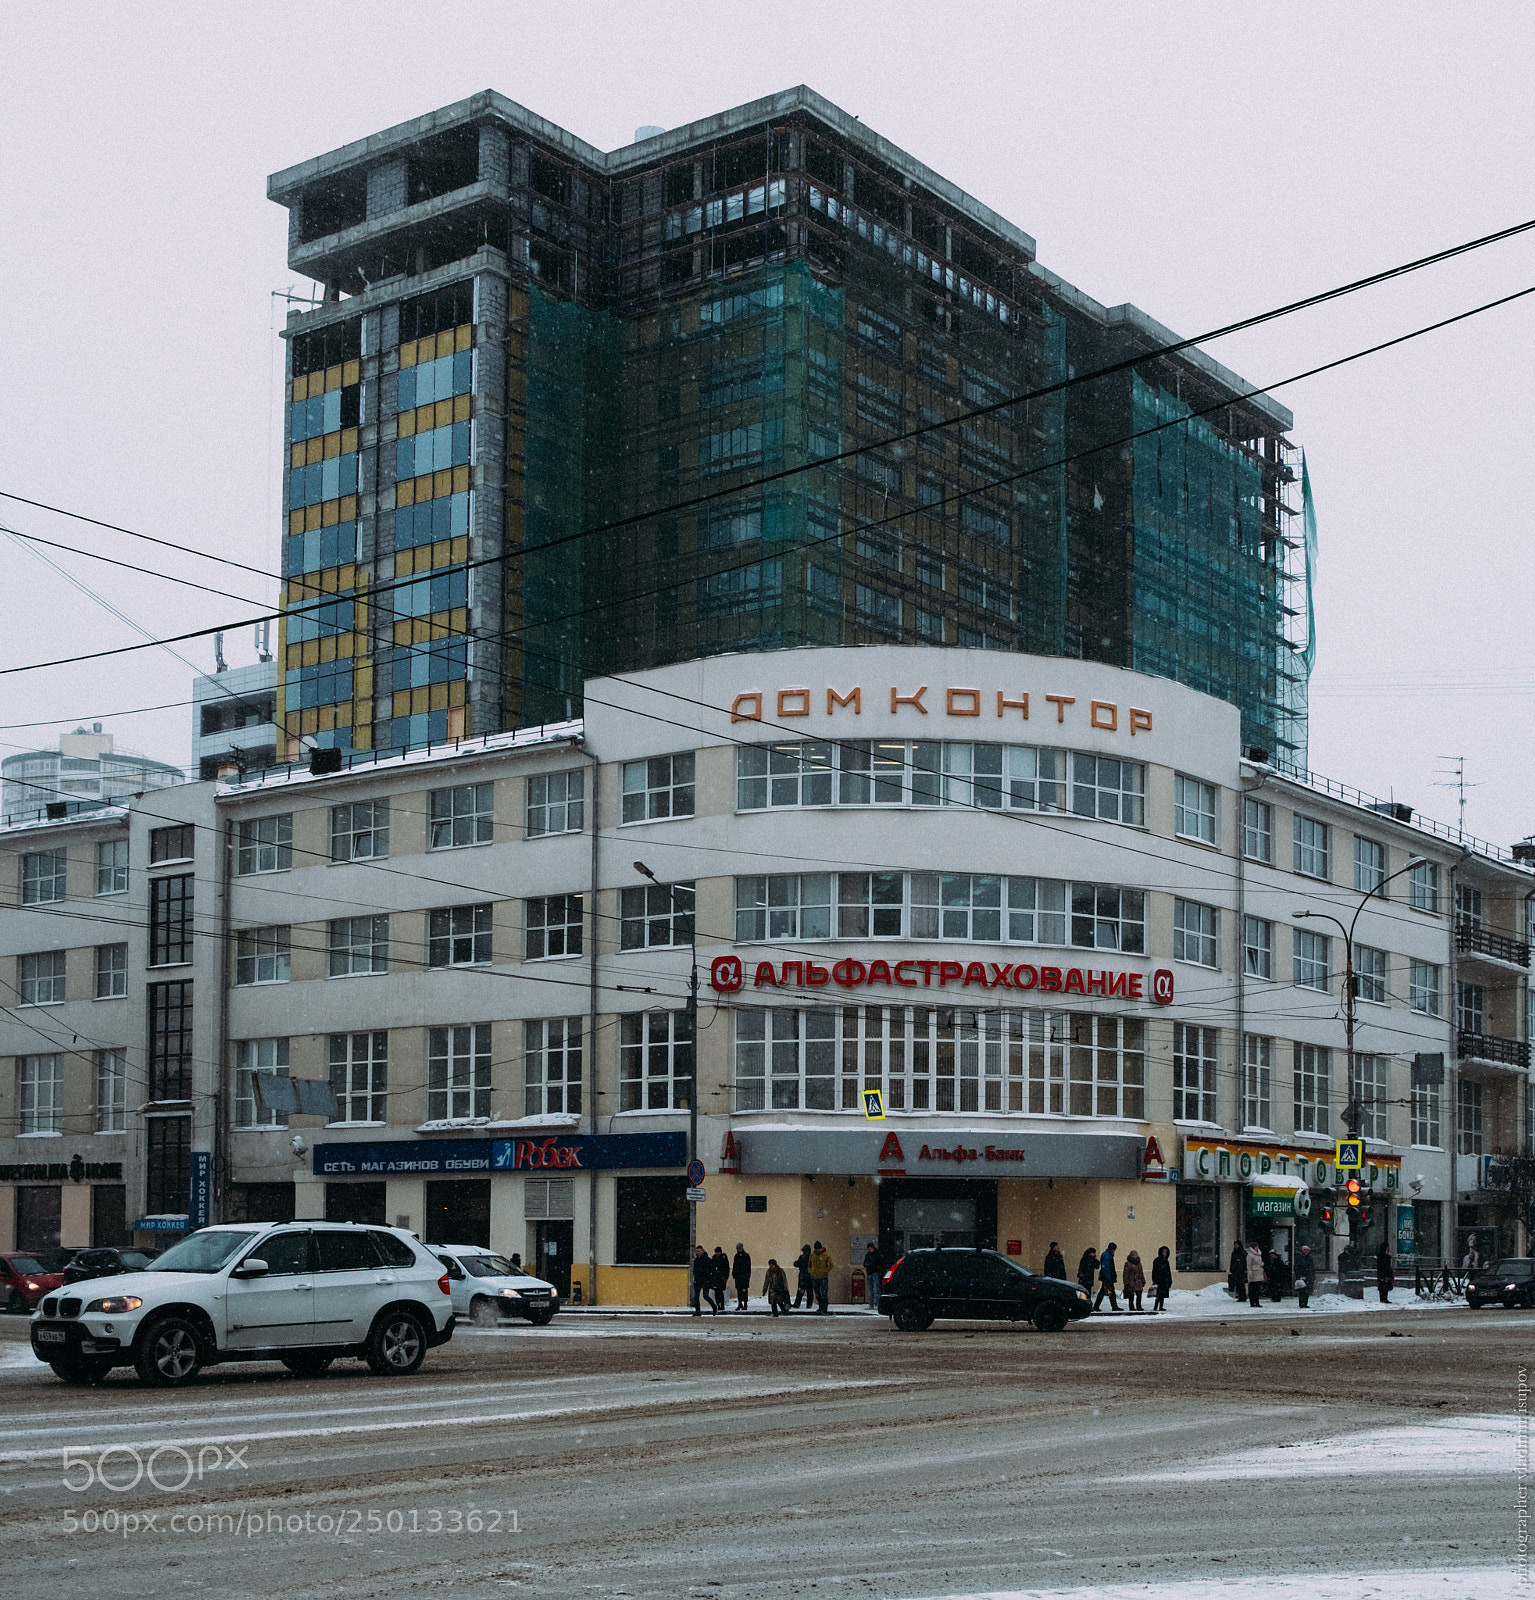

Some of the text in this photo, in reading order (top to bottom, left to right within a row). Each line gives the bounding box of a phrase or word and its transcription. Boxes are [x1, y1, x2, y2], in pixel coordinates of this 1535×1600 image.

[730, 686, 1153, 736] ДОМ КОНТОР
[753, 957, 1144, 999] АЛЬФАСТРАХОВАНИЕ
[323, 1159, 490, 1172] СЕТЬ МАГАЗИНОВ ОБУВИ
[514, 1137, 583, 1169] Робек
[1197, 1147, 1399, 1189] СПОРТТОВРЫ
[198, 1155, 207, 1224] МИР ХОККЕЯ
[1256, 1201, 1292, 1213] магазин
[140, 1221, 185, 1229] МИР ХОККЕЯ
